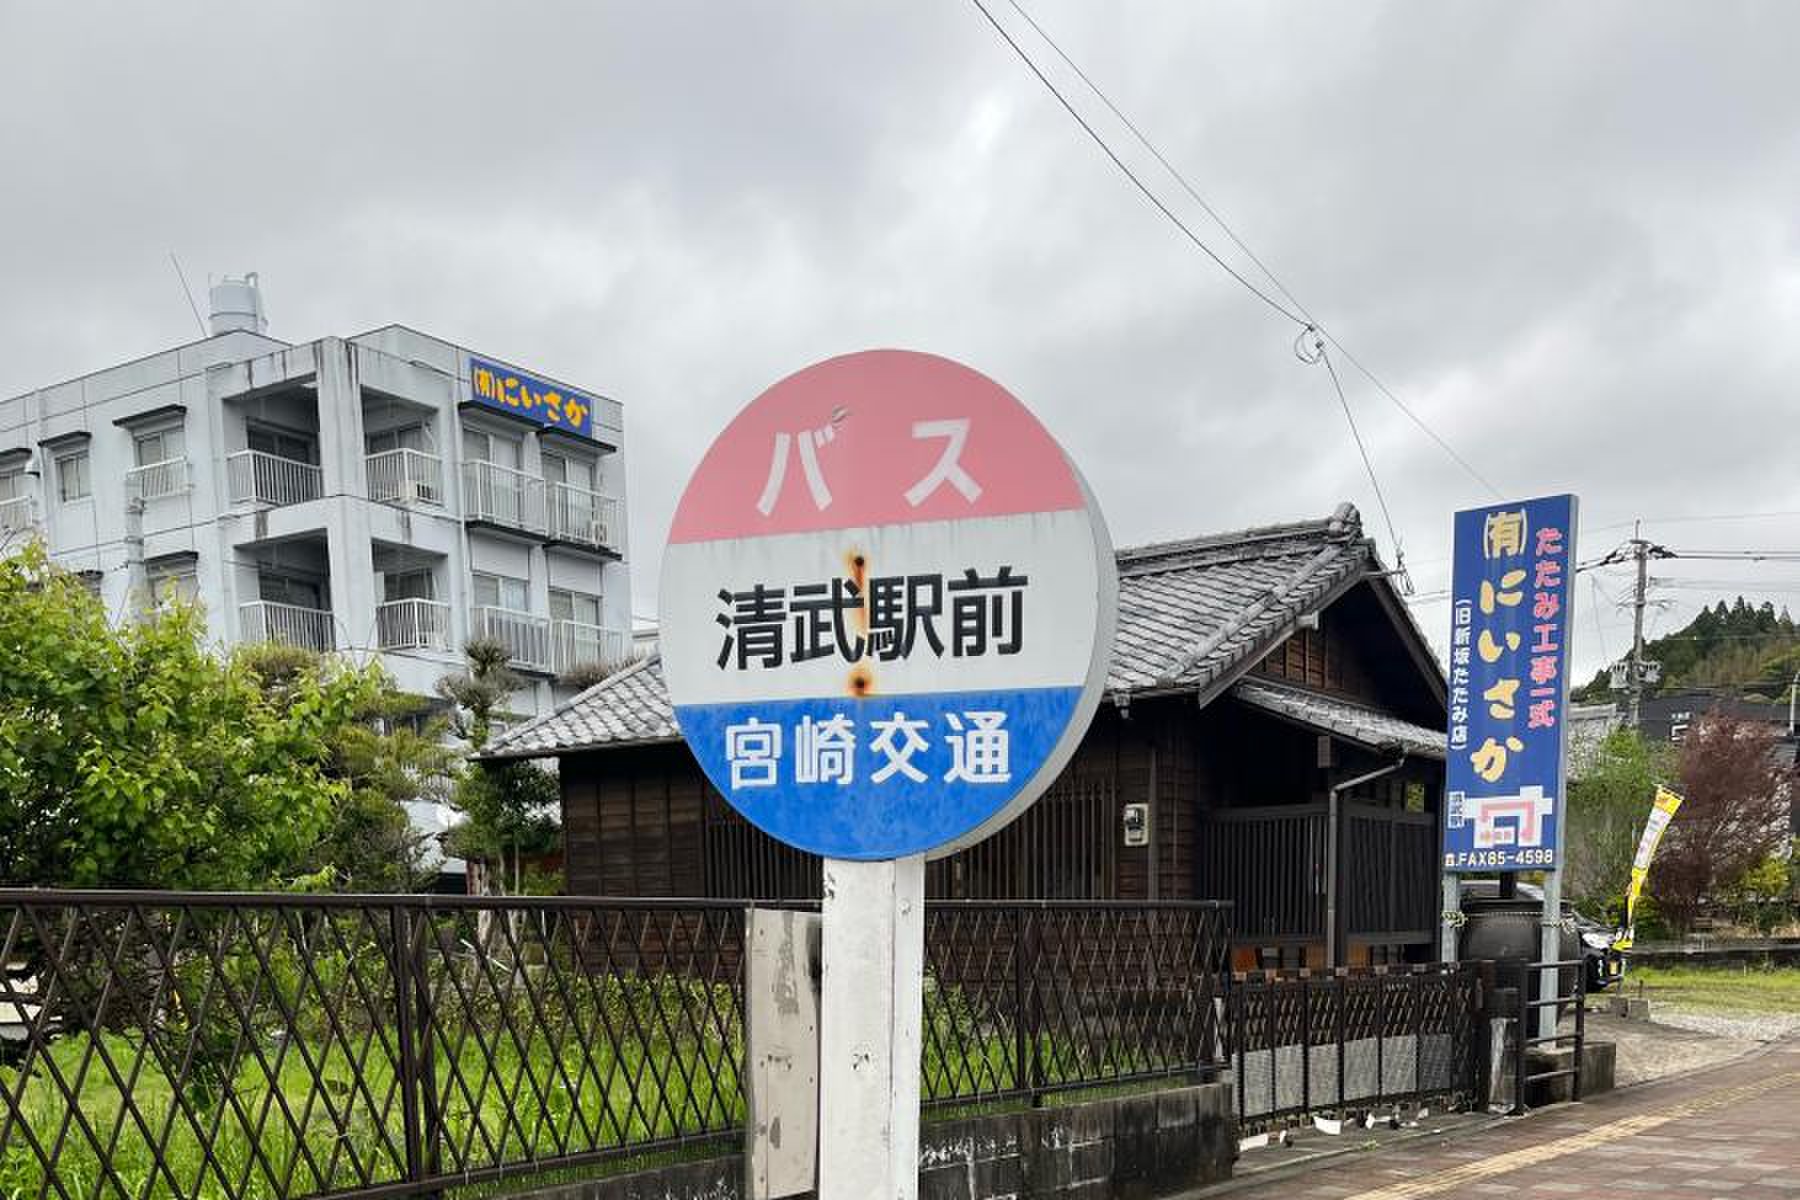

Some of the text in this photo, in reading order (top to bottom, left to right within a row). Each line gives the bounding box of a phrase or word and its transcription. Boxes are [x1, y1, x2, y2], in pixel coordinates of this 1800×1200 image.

[756, 416, 983, 517] バス
[715, 565, 1029, 671] 清武駅前
[1528, 527, 1563, 729] たたみ工事一式
[724, 711, 1012, 791] 宮崎交通
